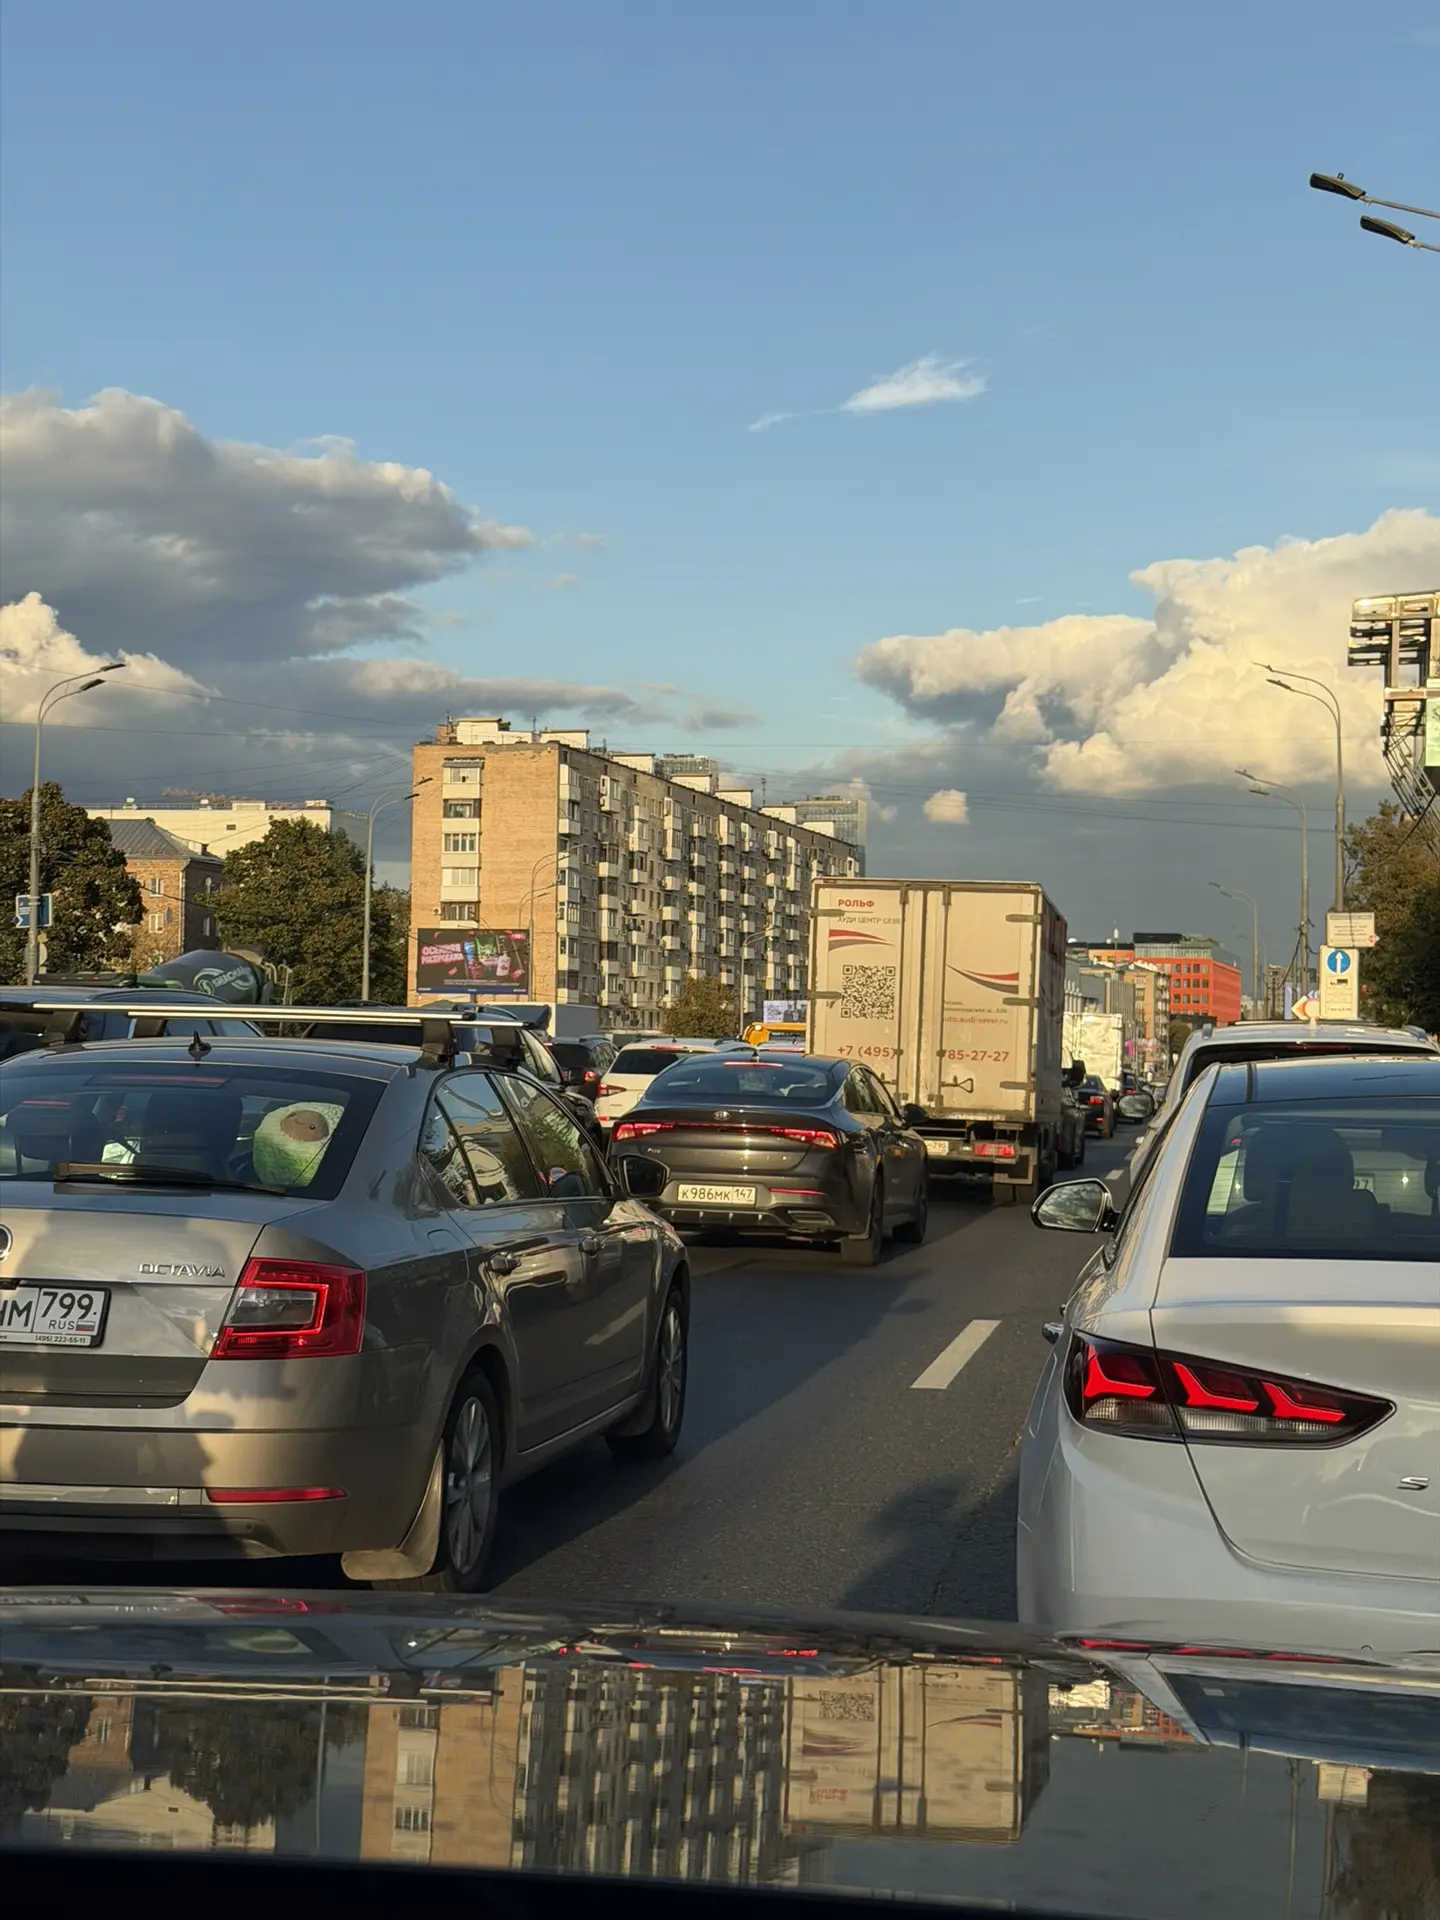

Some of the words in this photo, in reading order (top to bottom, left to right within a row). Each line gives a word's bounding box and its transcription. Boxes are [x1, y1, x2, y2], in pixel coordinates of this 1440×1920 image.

[838, 899, 875, 908] РОЛЬФ
[858, 916, 882, 924] ЦЕНТР
[838, 1045, 853, 1056] +7
[857, 1046, 897, 1060] (495)
[734, 1188, 753, 1199] 147
[138, 1263, 225, 1278] OCTAVIA
[41, 1291, 94, 1320] 799
[48, 1319, 75, 1331] RUS
